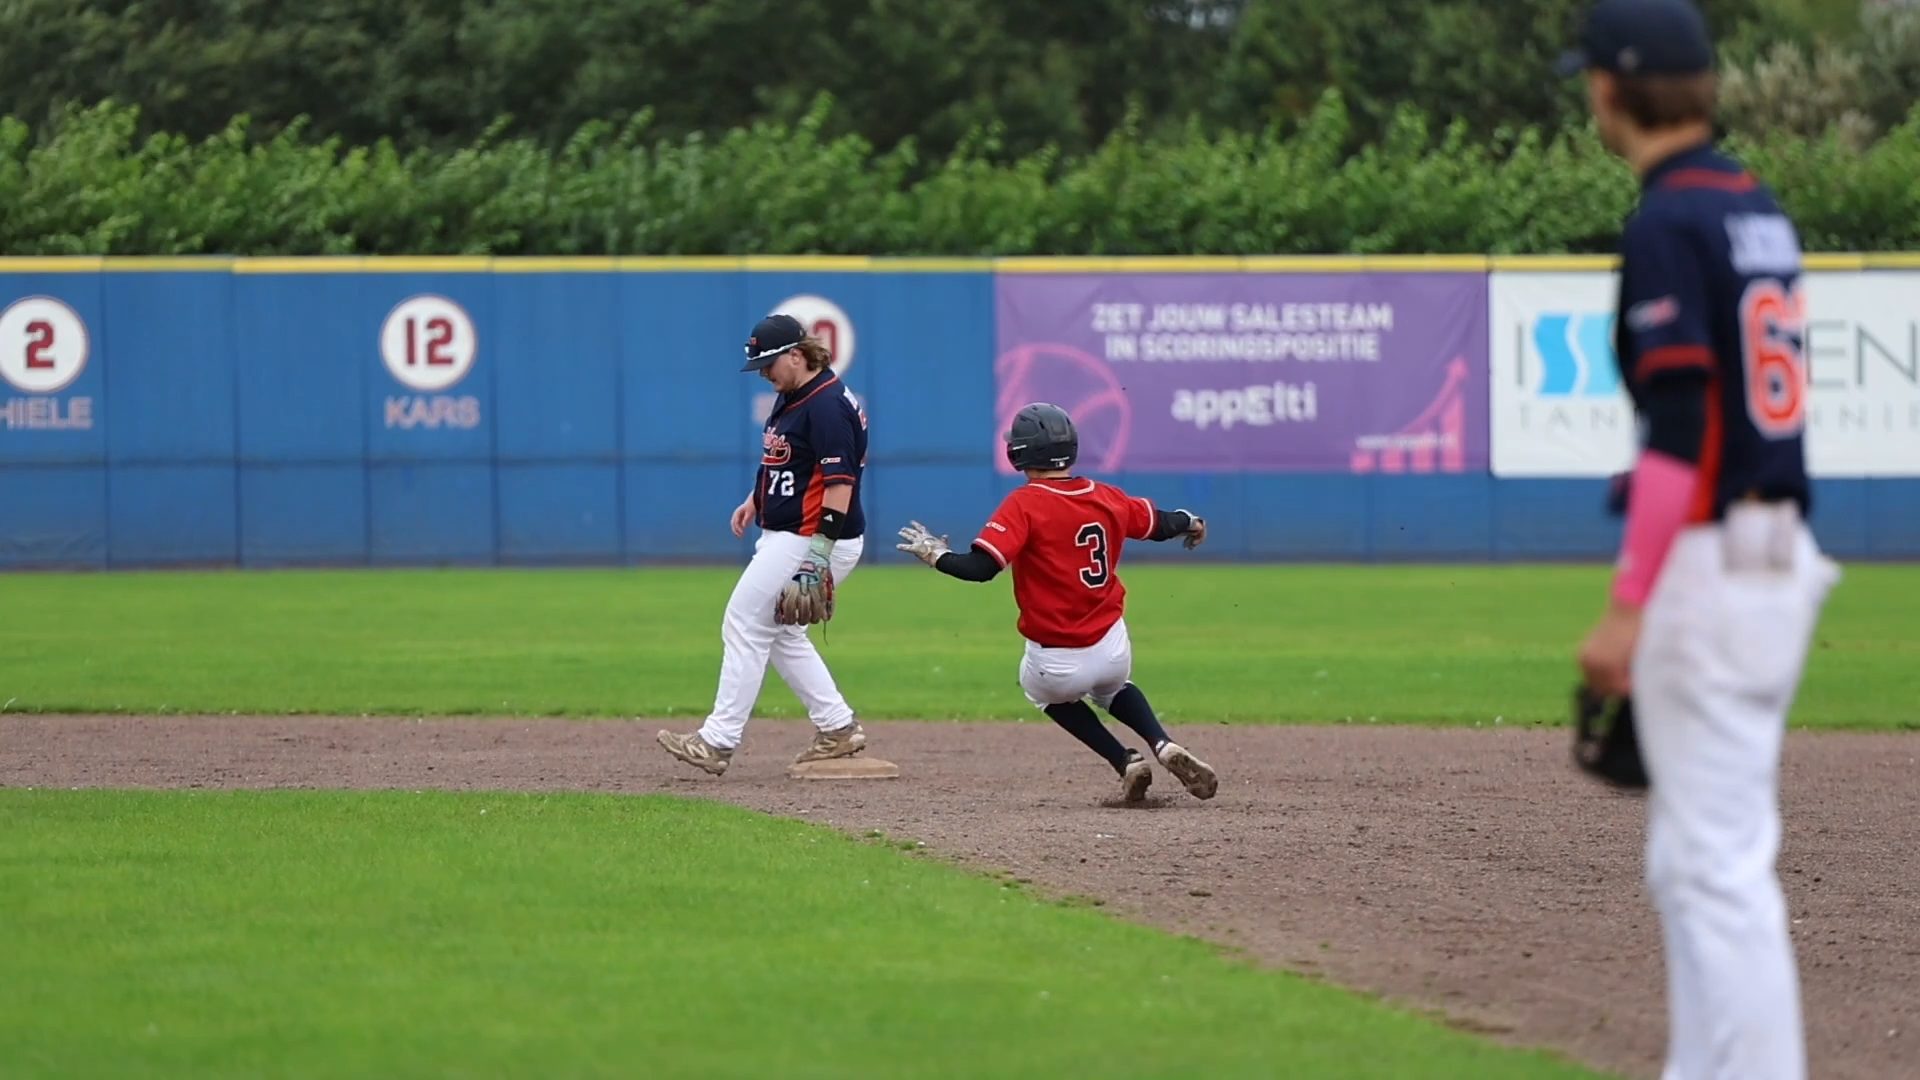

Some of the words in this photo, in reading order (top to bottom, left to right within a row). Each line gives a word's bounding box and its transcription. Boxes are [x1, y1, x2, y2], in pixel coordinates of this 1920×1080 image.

[1092, 303, 1143, 331] ZET
[1147, 303, 1226, 331] JOUW
[1230, 303, 1393, 331] SALESTEAM
[25, 320, 55, 369] 2
[406, 317, 454, 366] 12
[1105, 333, 1138, 361] IN
[1140, 333, 1381, 361] SCORINGSPOSITIE
[384, 396, 480, 430] KARS
[768, 470, 795, 496] 72
[1075, 522, 1108, 588] 3
